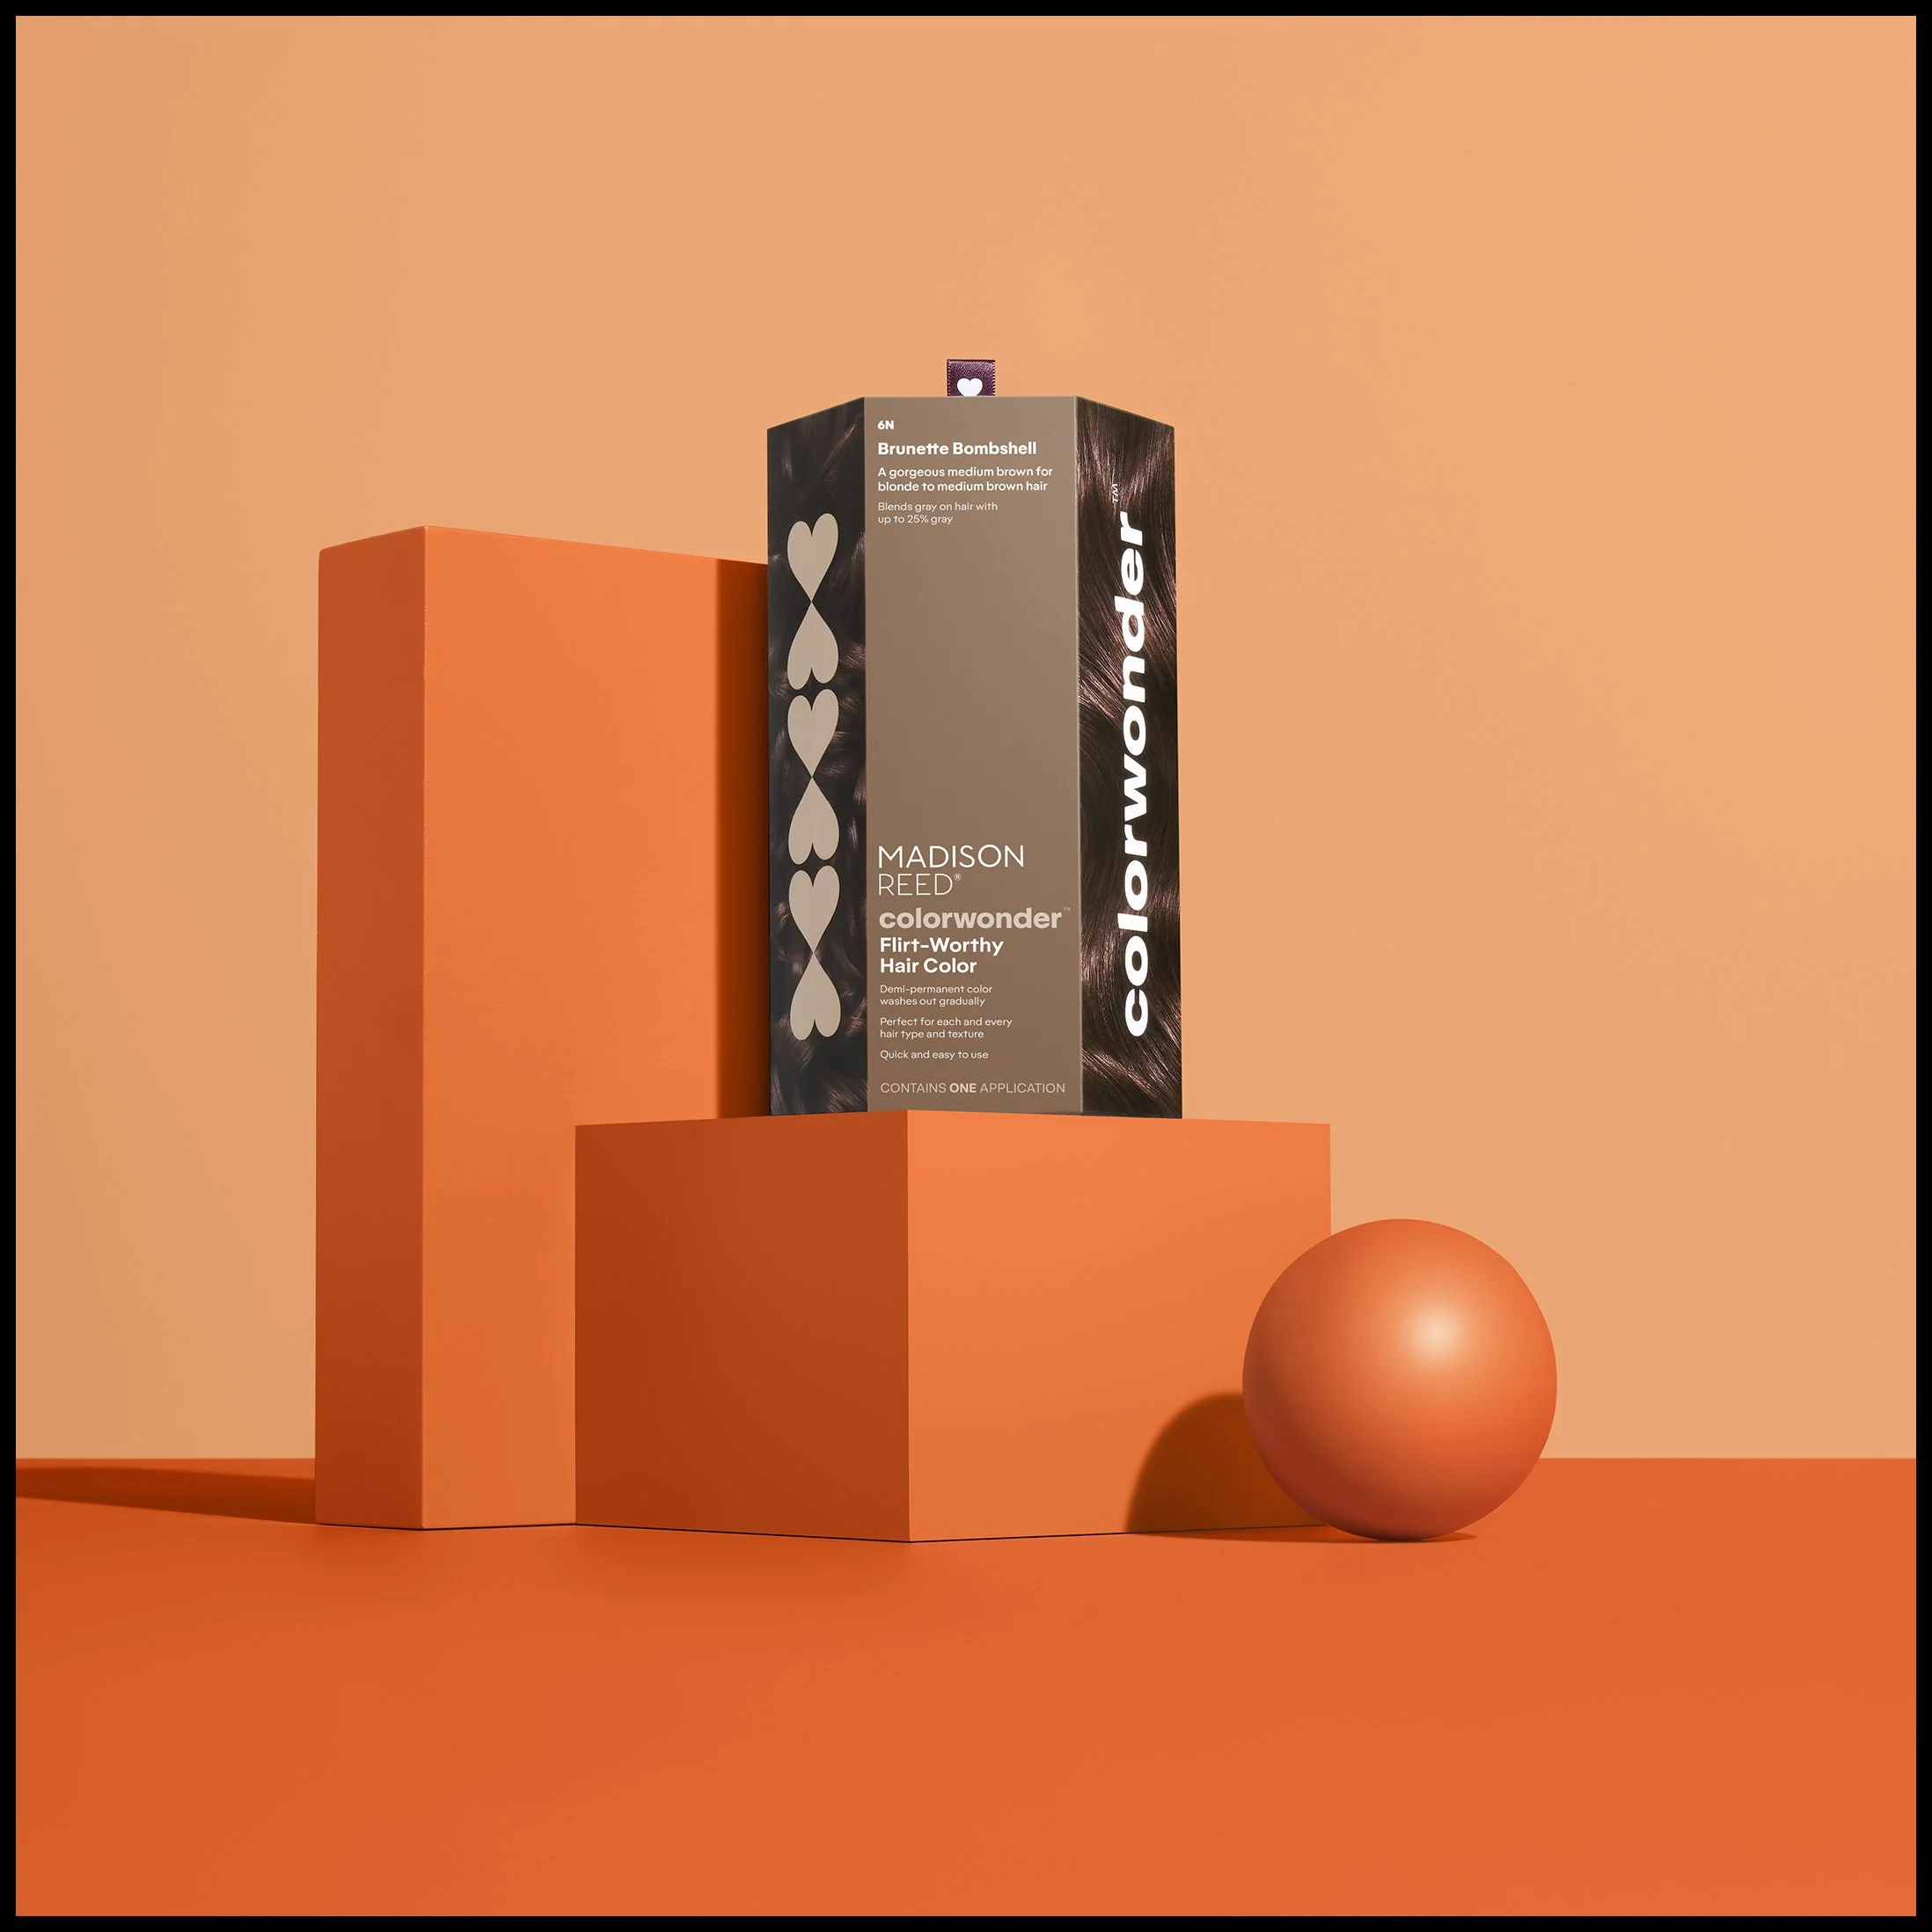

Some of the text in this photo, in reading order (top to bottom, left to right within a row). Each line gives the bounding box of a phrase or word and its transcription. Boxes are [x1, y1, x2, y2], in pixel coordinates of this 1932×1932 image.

[877, 421, 894, 429] 6N
[878, 442, 1036, 455] Brunette Bombshell
[878, 466, 1053, 479] A gorgeous medium brown for
[878, 481, 1048, 491] blonde to medium brown hair
[878, 501, 912, 510] Blends
[915, 504, 937, 513] gray
[955, 501, 973, 510] hair
[976, 501, 998, 510] with
[878, 516, 891, 525] up
[894, 515, 904, 523] to
[931, 516, 953, 525] gray
[879, 844, 1024, 868] MADISON
[881, 936, 1004, 956] Flirt-Worthy
[881, 957, 977, 973] Hair Color
[881, 984, 992, 995] Demi-permanent color
[939, 997, 985, 1007] gradually
[881, 1017, 918, 1026] Perfect
[919, 1017, 935, 1026] for
[937, 1017, 961, 1026] each
[963, 1017, 982, 1027] and
[881, 1029, 898, 1038] hair
[901, 1030, 924, 1040] type
[926, 1029, 945, 1038] and
[880, 1049, 909, 1059] Quick
[911, 1049, 931, 1058] and
[881, 1083, 1065, 1094] CONTAINS ONE APPLICATION
